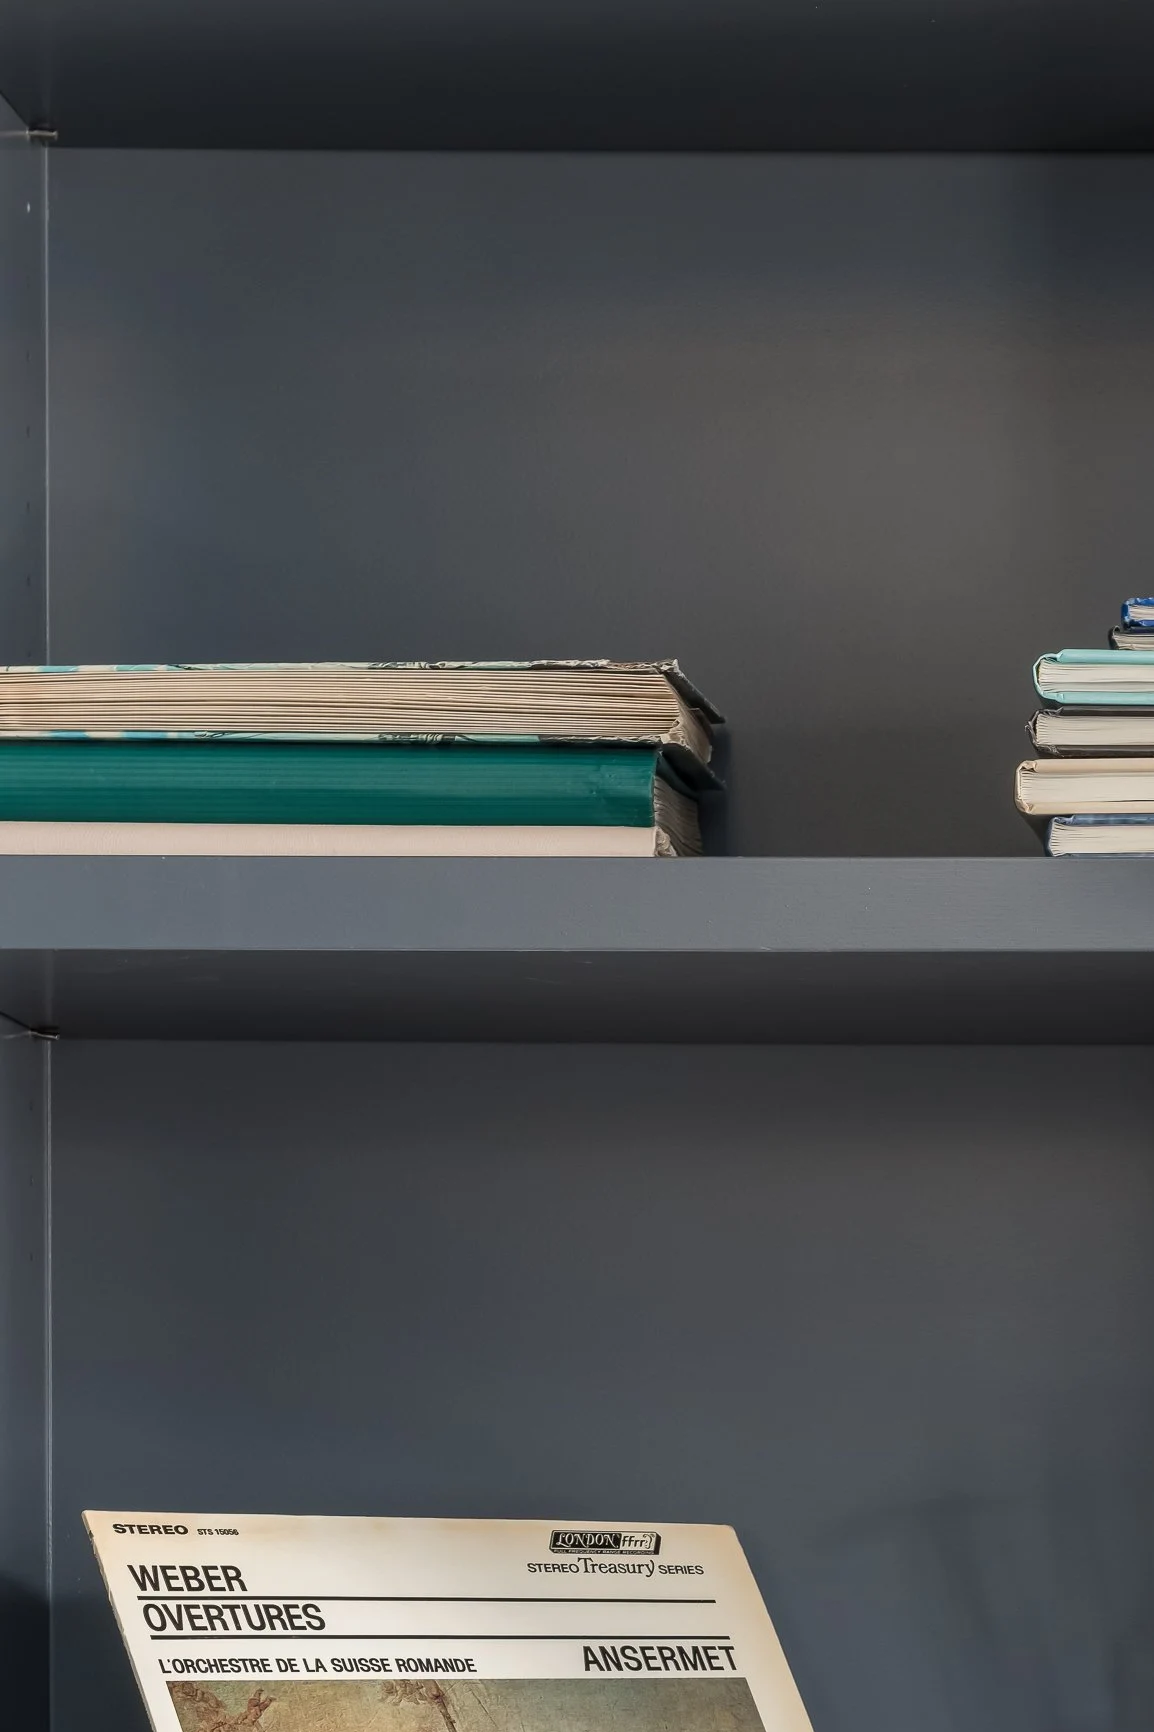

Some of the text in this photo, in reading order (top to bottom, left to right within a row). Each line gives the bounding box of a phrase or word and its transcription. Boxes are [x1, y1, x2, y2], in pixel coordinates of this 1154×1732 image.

[112, 1523, 189, 1535] STEREO
[196, 1528, 214, 1536] STS
[555, 1532, 620, 1548] LONDON
[127, 1564, 248, 1592] WEBER
[527, 1557, 705, 1578] STEREO Treasury SERIES
[142, 1603, 326, 1632] OVERTURES
[158, 1657, 478, 1674] L'ORCHESTRE DE LA SUISSE ROMANDE
[582, 1645, 738, 1672] ANSERMET
